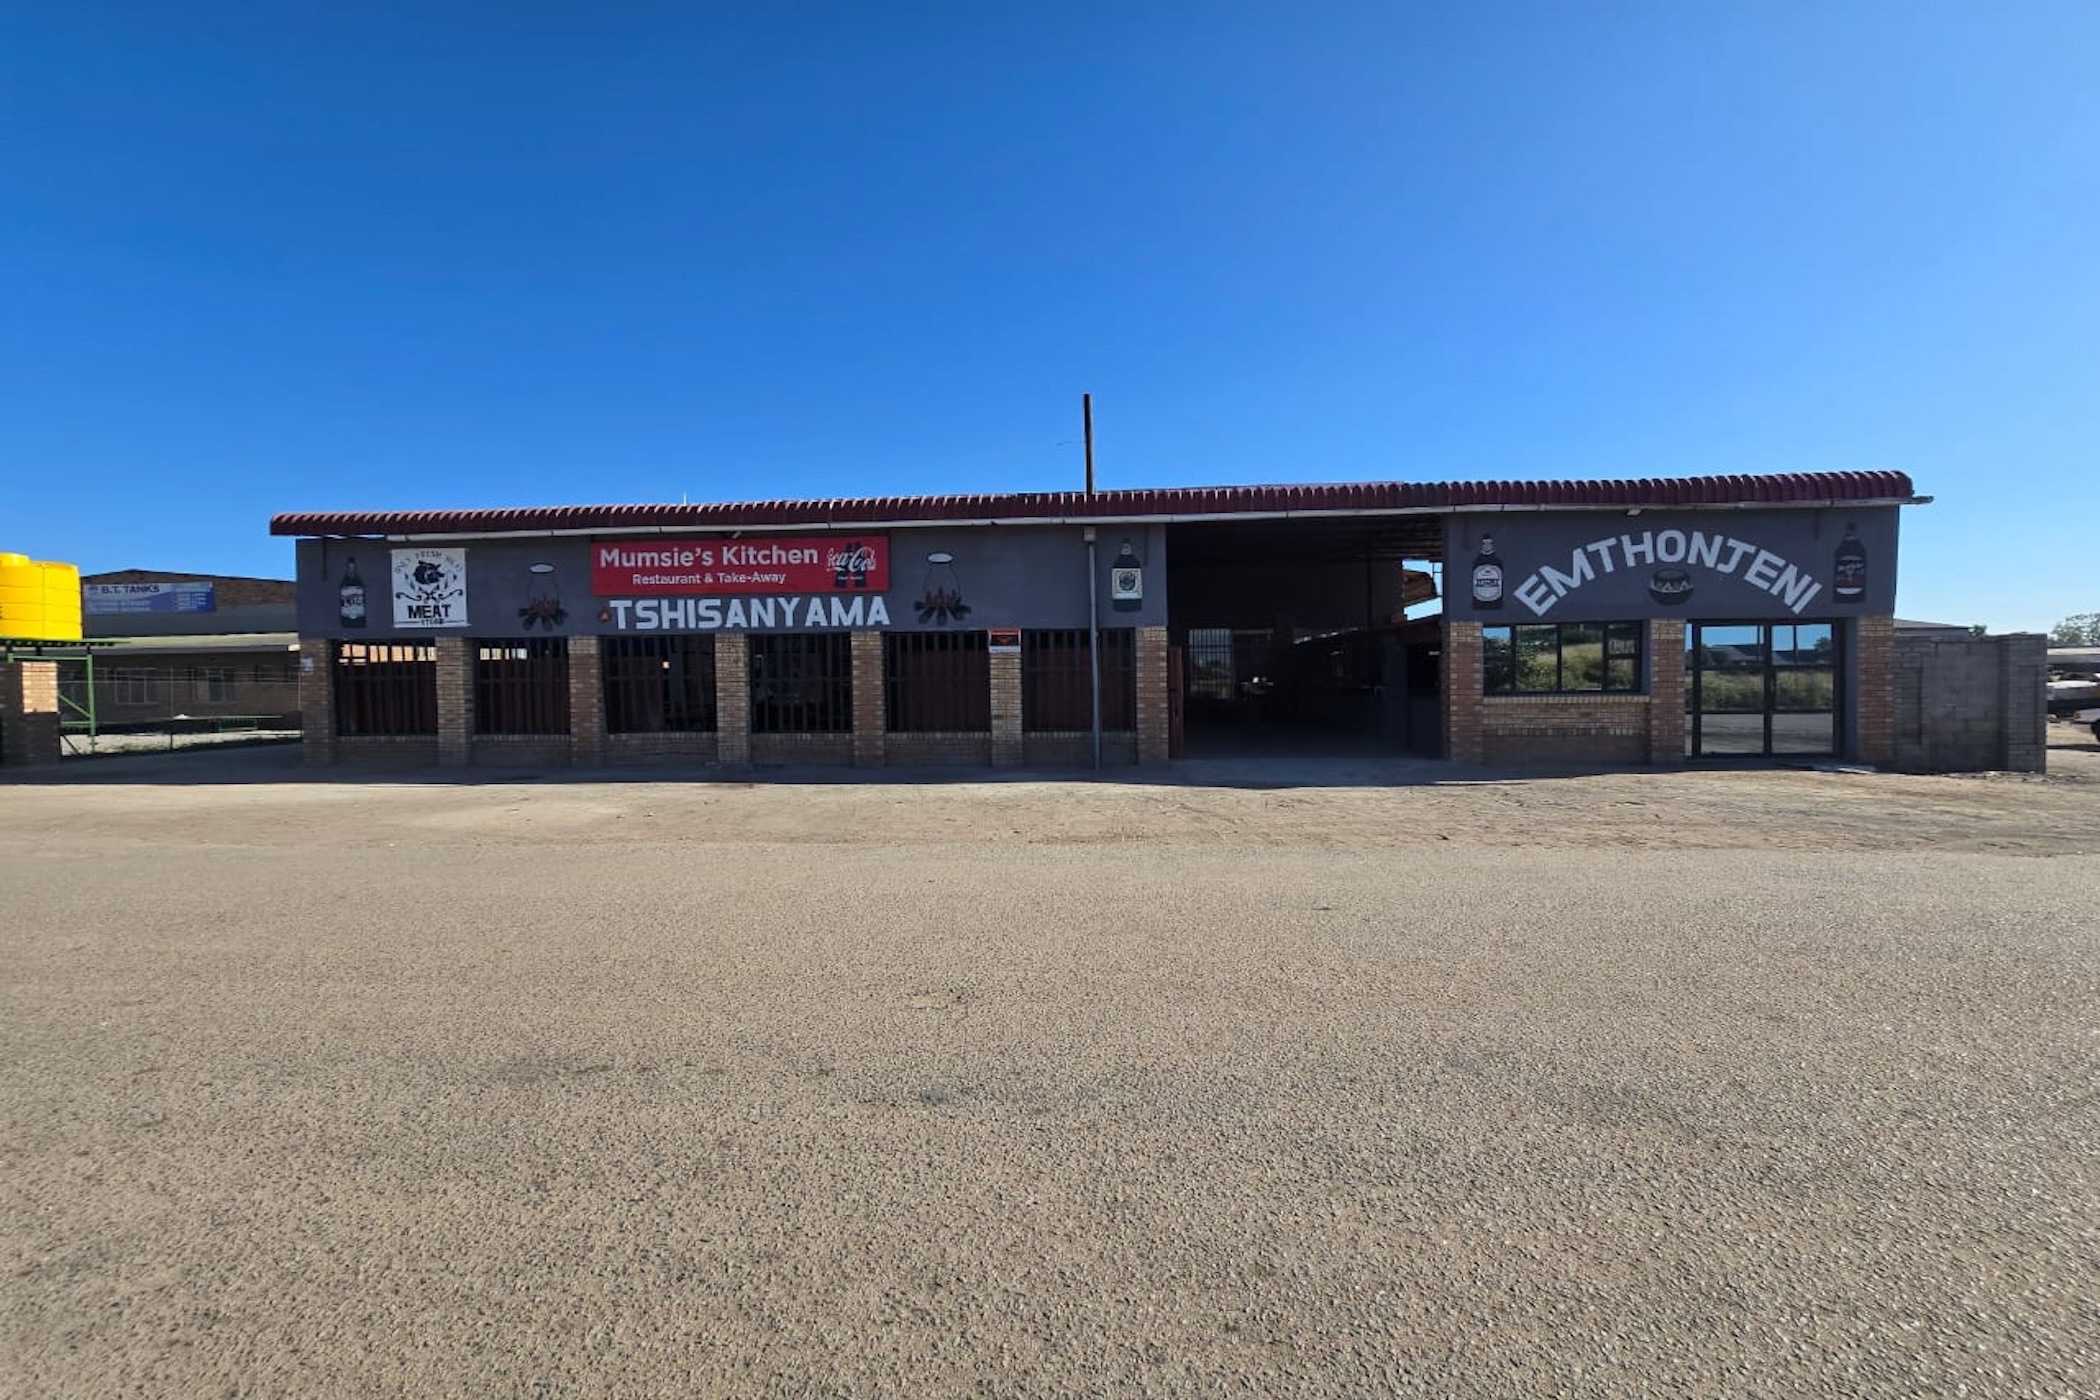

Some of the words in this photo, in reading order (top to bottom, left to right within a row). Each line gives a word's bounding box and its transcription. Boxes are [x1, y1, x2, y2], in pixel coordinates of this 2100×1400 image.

[600, 547, 715, 568] Mumsie's
[722, 545, 819, 566] Kitchen
[632, 573, 701, 585] Restaurant
[704, 573, 714, 584] &
[716, 571, 787, 584] Take-Away
[1513, 529, 1822, 617] EMTHONJENI
[125, 585, 160, 593] TANKS
[407, 604, 452, 619] MEAT
[609, 596, 891, 630] TSHISANYAMA
